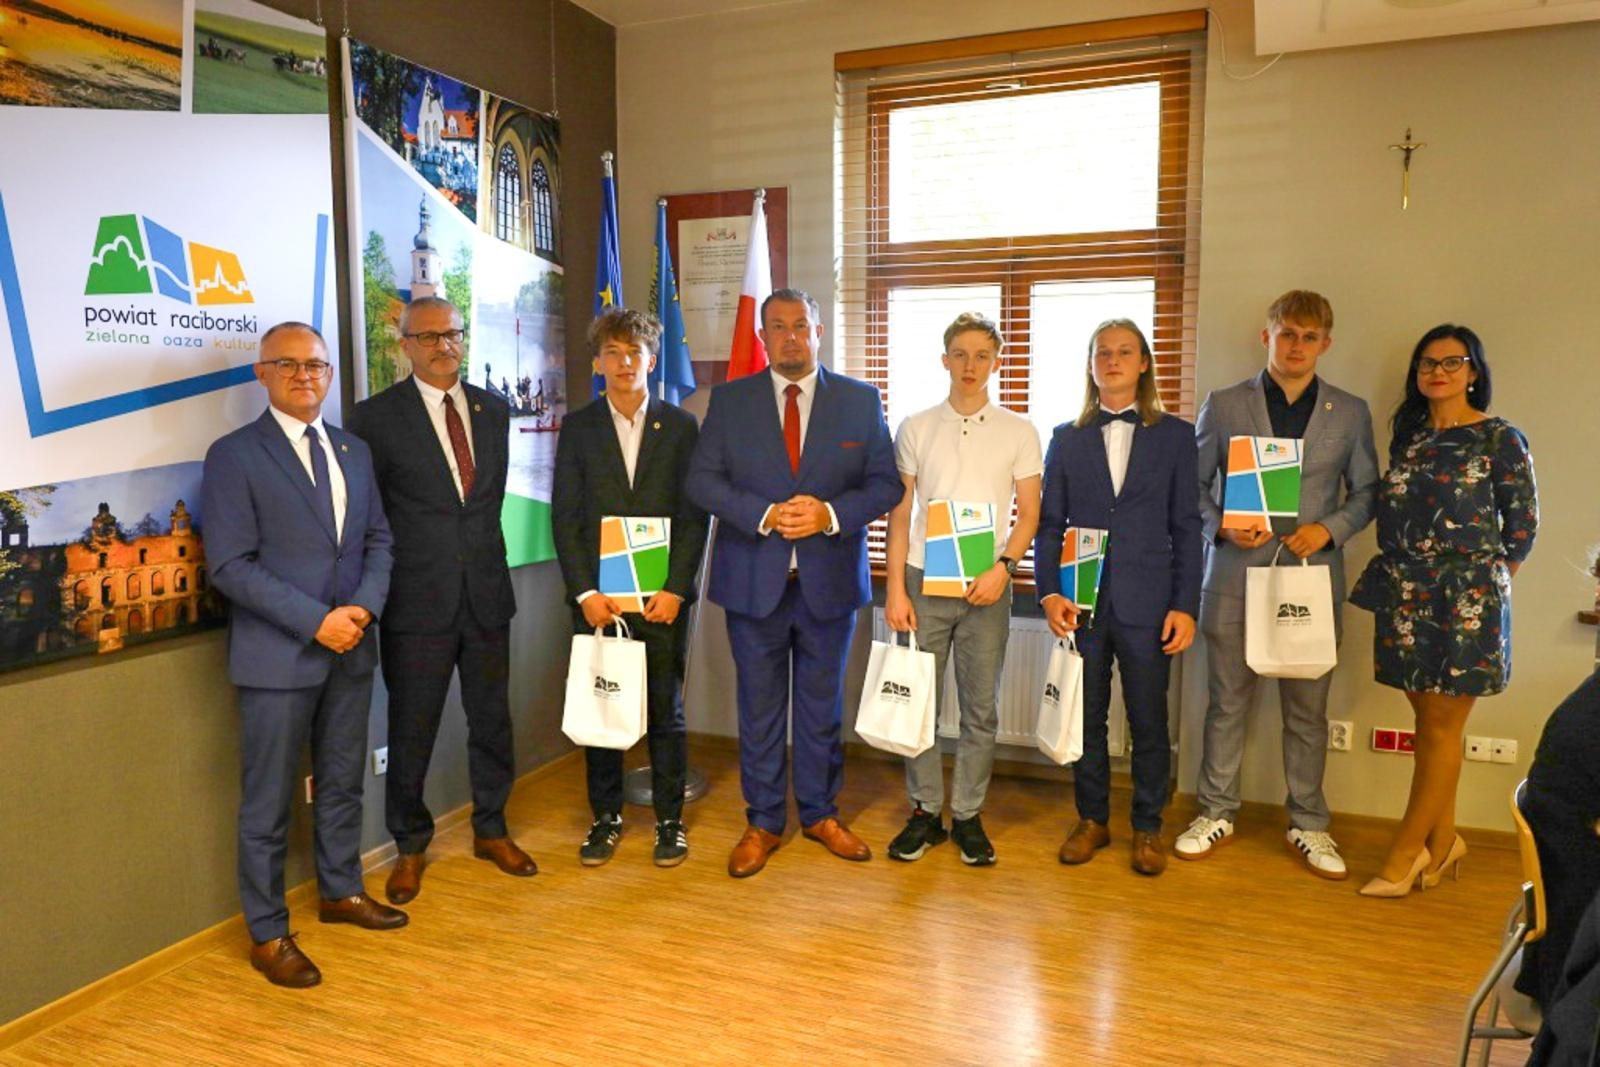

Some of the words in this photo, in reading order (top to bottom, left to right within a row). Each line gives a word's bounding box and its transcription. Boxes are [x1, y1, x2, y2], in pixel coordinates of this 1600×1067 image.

[84, 304, 157, 327] powiat
[170, 310, 257, 332] raciborski
[85, 328, 150, 344] zielona
[163, 335, 203, 348] oaza
[214, 338, 257, 350] kultur
